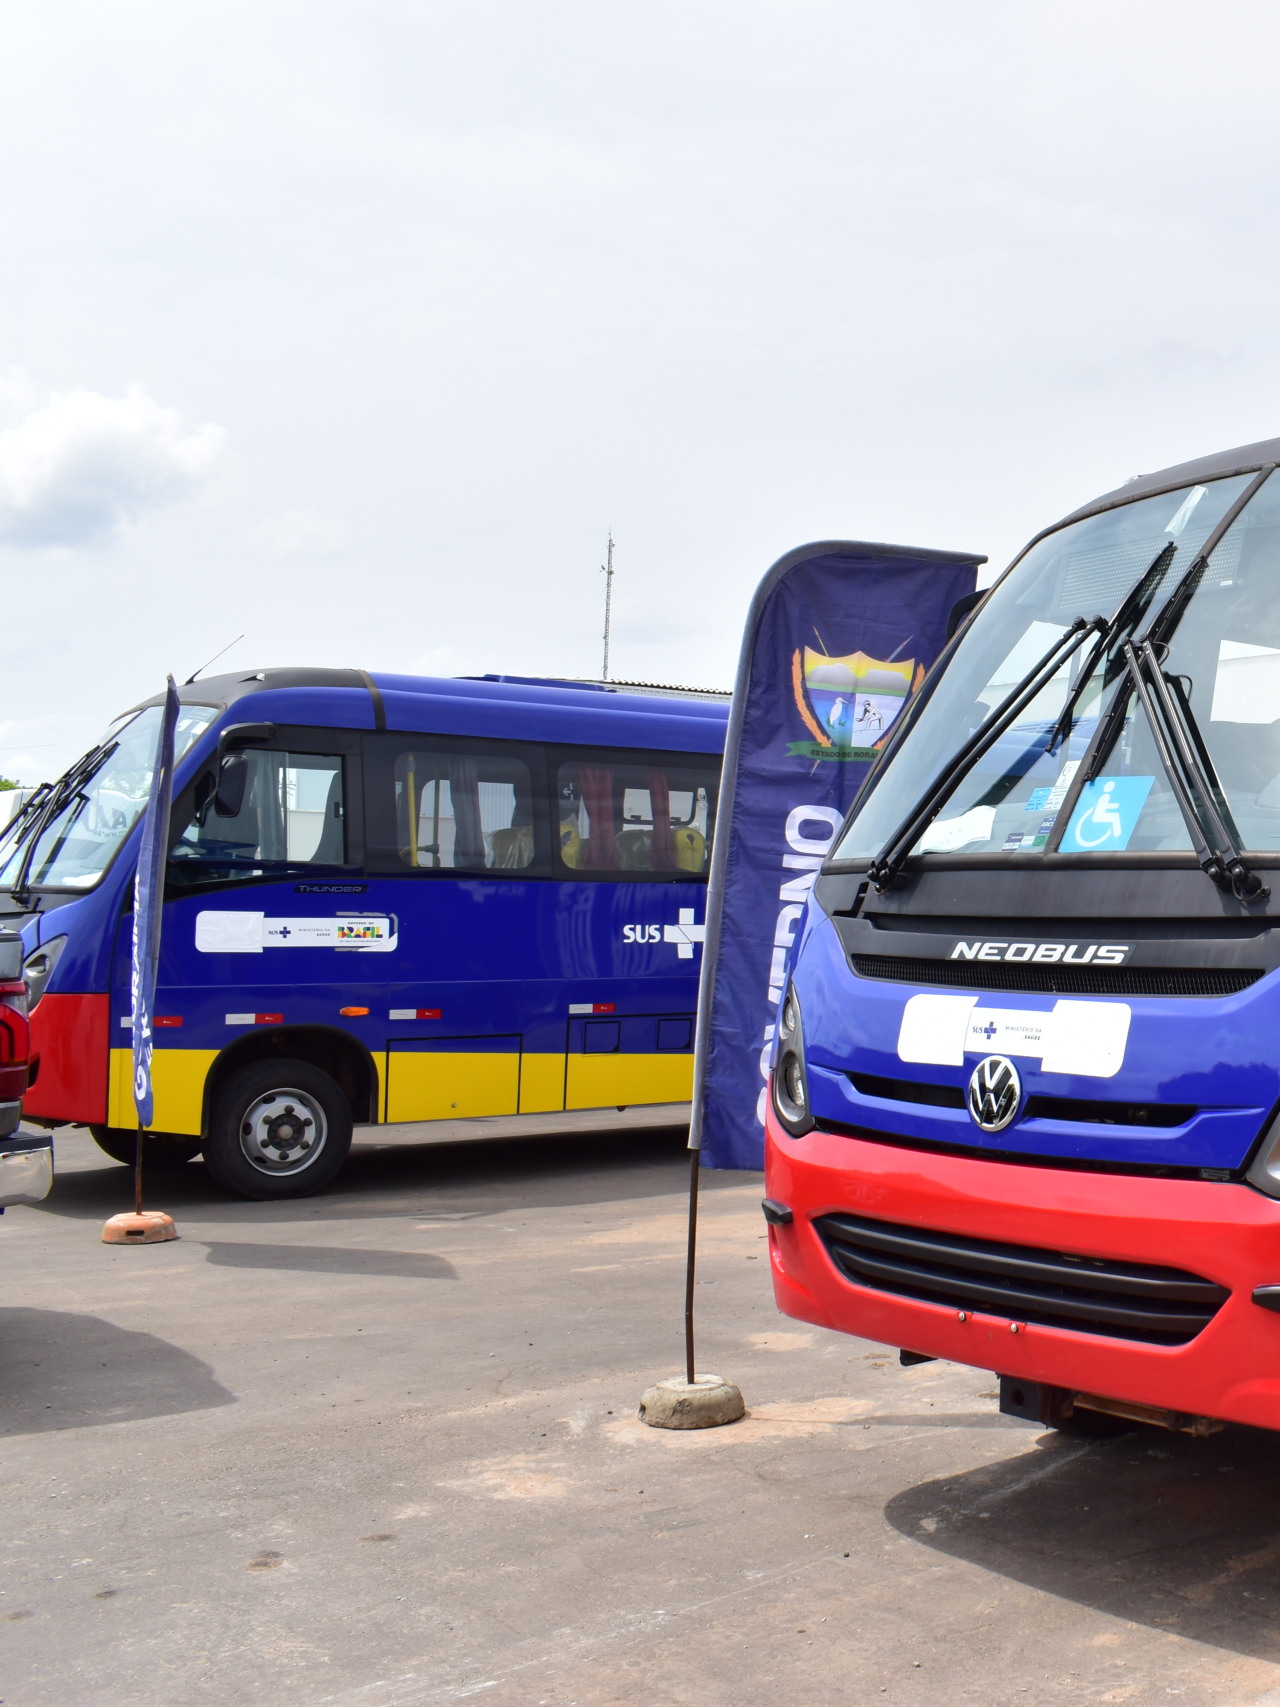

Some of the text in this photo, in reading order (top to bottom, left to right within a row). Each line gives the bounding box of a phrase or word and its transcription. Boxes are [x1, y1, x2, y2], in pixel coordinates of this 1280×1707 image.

[811, 749, 840, 758] ESTADO
[298, 885, 362, 893] THUNDER
[337, 926, 384, 939] BRASIL
[623, 924, 660, 944] SUS
[950, 941, 1129, 965] NEOBUS
[756, 804, 845, 1127] ERNO
[972, 1025, 983, 1034] SUS
